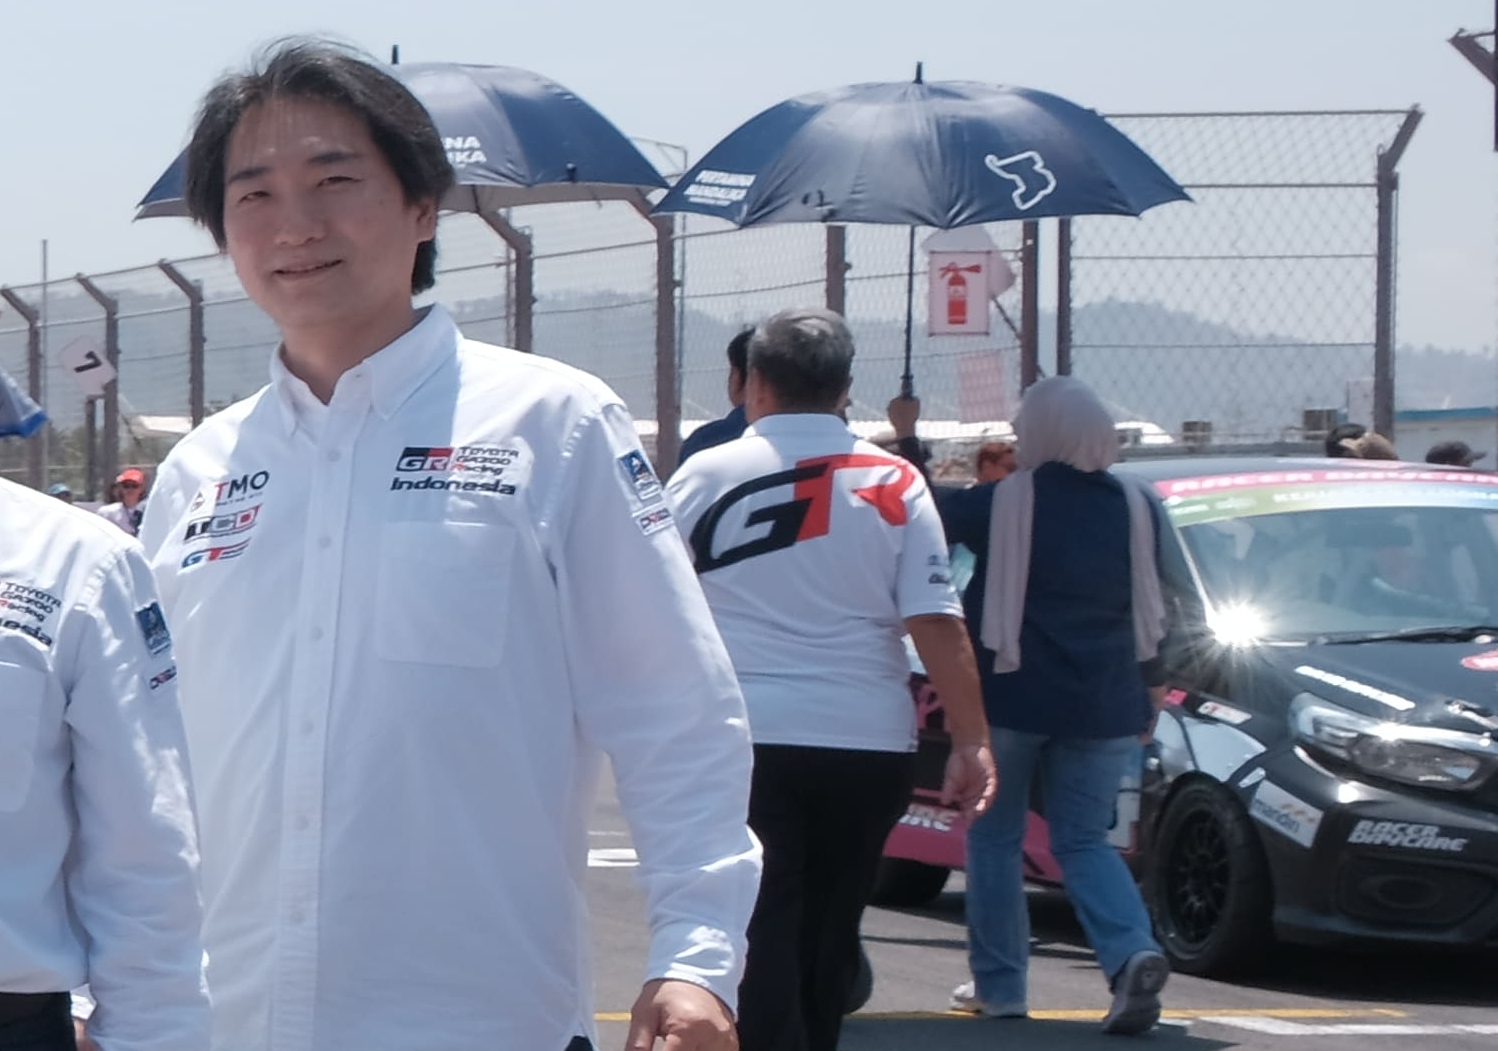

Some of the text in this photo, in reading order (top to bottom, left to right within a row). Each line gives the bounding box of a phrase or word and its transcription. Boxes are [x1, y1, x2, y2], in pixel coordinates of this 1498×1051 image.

[397, 449, 453, 471] GR
[457, 446, 519, 458] TOYOTA
[215, 470, 270, 502] TMO
[390, 476, 516, 495] Indonesia
[690, 454, 916, 574] GR
[5, 582, 63, 608] TOYOTA
[1354, 820, 1440, 839] RACER
